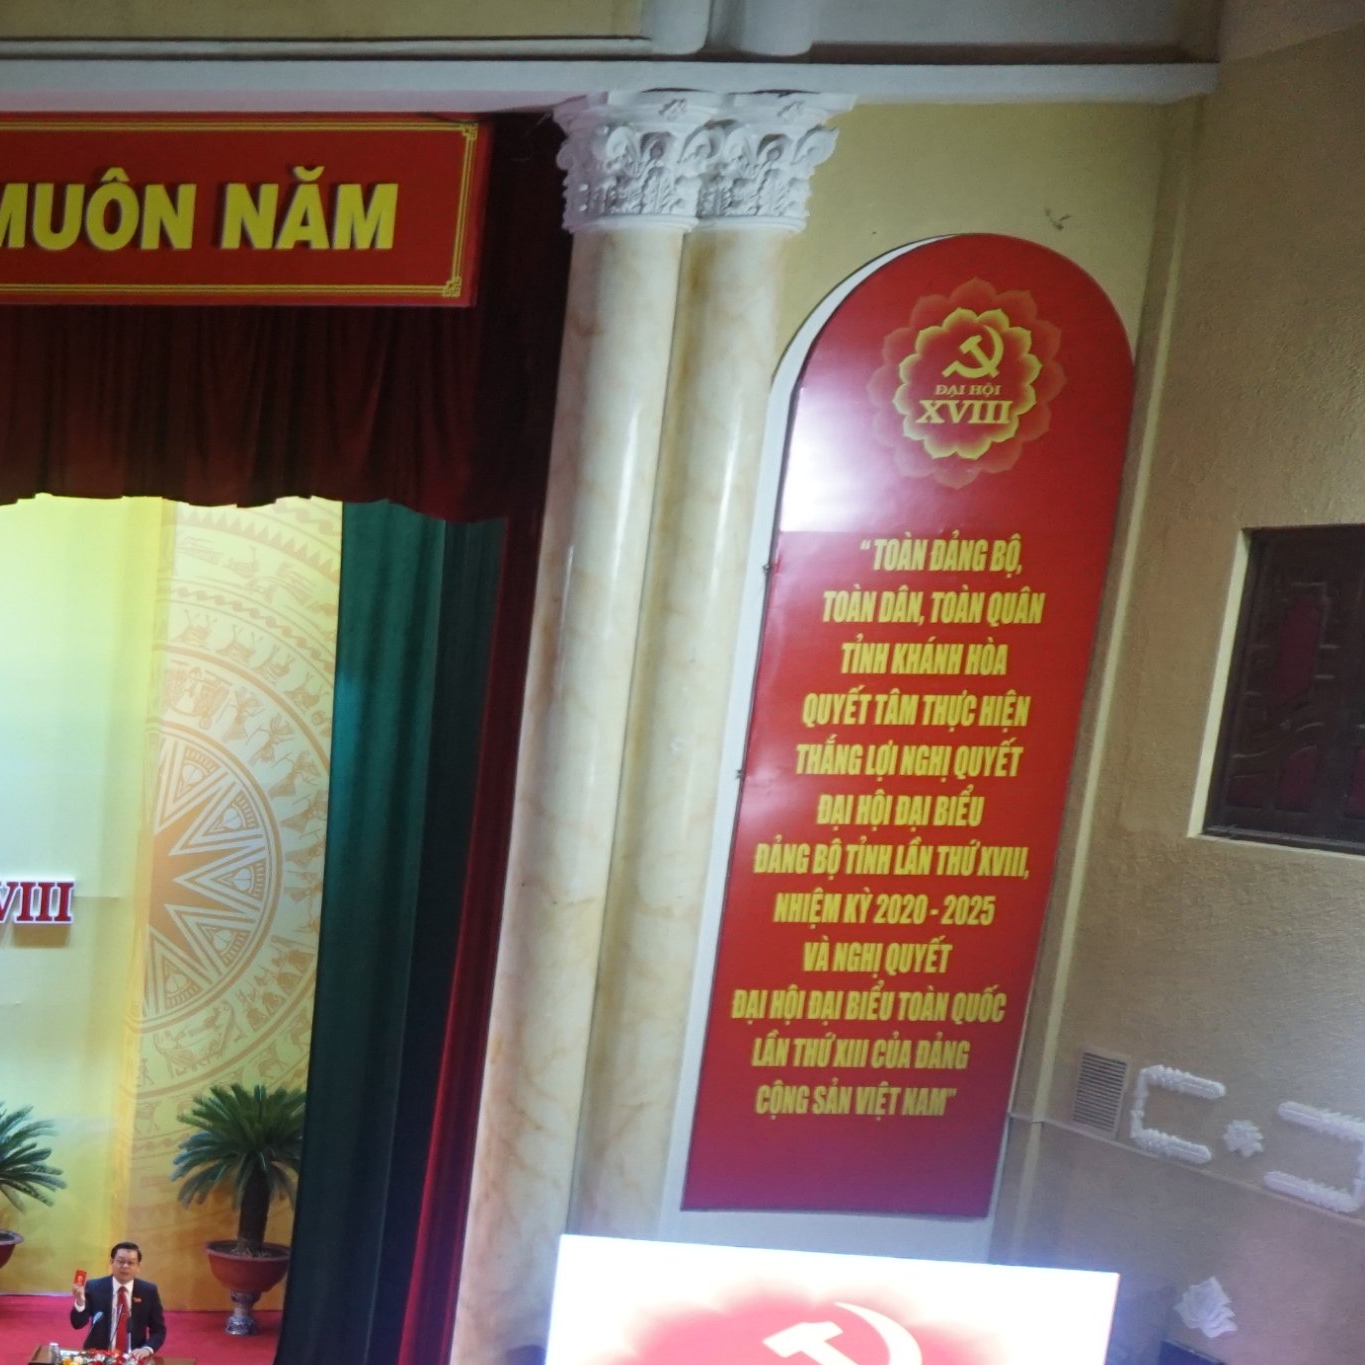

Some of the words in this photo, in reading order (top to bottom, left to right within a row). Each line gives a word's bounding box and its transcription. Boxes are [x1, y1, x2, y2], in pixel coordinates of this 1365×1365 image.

[219, 165, 399, 251] NĂM
[915, 400, 1013, 424] XVIII
[935, 384, 966, 397] ĐẠI
[969, 383, 1002, 397] HỘI
[929, 530, 988, 571] ĐẢNG
[990, 533, 1022, 578] BỘ,
[823, 584, 876, 623] TOÀN
[879, 584, 924, 625] DÂN,
[930, 584, 985, 624] TOÀN
[986, 586, 1045, 627] QUÂN
[841, 633, 890, 674] TỈNH
[891, 637, 964, 675] KHÁNH
[964, 637, 1008, 675] HÒA
[802, 685, 872, 728] QUYẾT
[874, 688, 921, 725] TÂM
[922, 690, 977, 732] THỰC
[978, 690, 1031, 733] HIỆN
[796, 734, 863, 775] THẮNG
[865, 740, 897, 782] LỢI
[900, 745, 952, 782] NGHỊ
[953, 737, 1024, 780] QUYẾT
[816, 794, 854, 831] ĐẠI
[855, 789, 893, 831] HỘI
[894, 795, 933, 832] ĐẠI
[933, 784, 985, 826] BIỂU
[753, 835, 811, 874] ĐẢNG
[812, 838, 842, 880] BỘ
[845, 836, 893, 875] TỈNH
[894, 836, 933, 875] LẦN
[936, 839, 980, 876] THỨ
[977, 846, 1029, 879] XVIII,
[774, 887, 842, 928] NHIỆM
[843, 887, 873, 923] KỲ
[873, 895, 928, 924] 2020
[940, 896, 996, 925] 2025
[803, 935, 830, 971] VÀ
[832, 943, 884, 978] NGHỊ
[884, 935, 952, 975] QUYẾT
[731, 989, 768, 1025] ĐẠI
[768, 984, 806, 1025] HỘI
[807, 990, 844, 1026] ĐẠI
[844, 979, 895, 1021] BIỂU
[898, 984, 950, 1021] TOÀN
[951, 984, 1007, 1024] QUỐC
[751, 1029, 790, 1067] LẦN
[793, 1032, 836, 1068] THỨ
[833, 1039, 869, 1068] XIII
[871, 1031, 912, 1068] CỦA
[915, 1031, 970, 1069] ĐẢNG
[755, 1080, 810, 1120] CỘNG
[812, 1077, 853, 1115] SẢN
[855, 1081, 902, 1121] VIỆT
